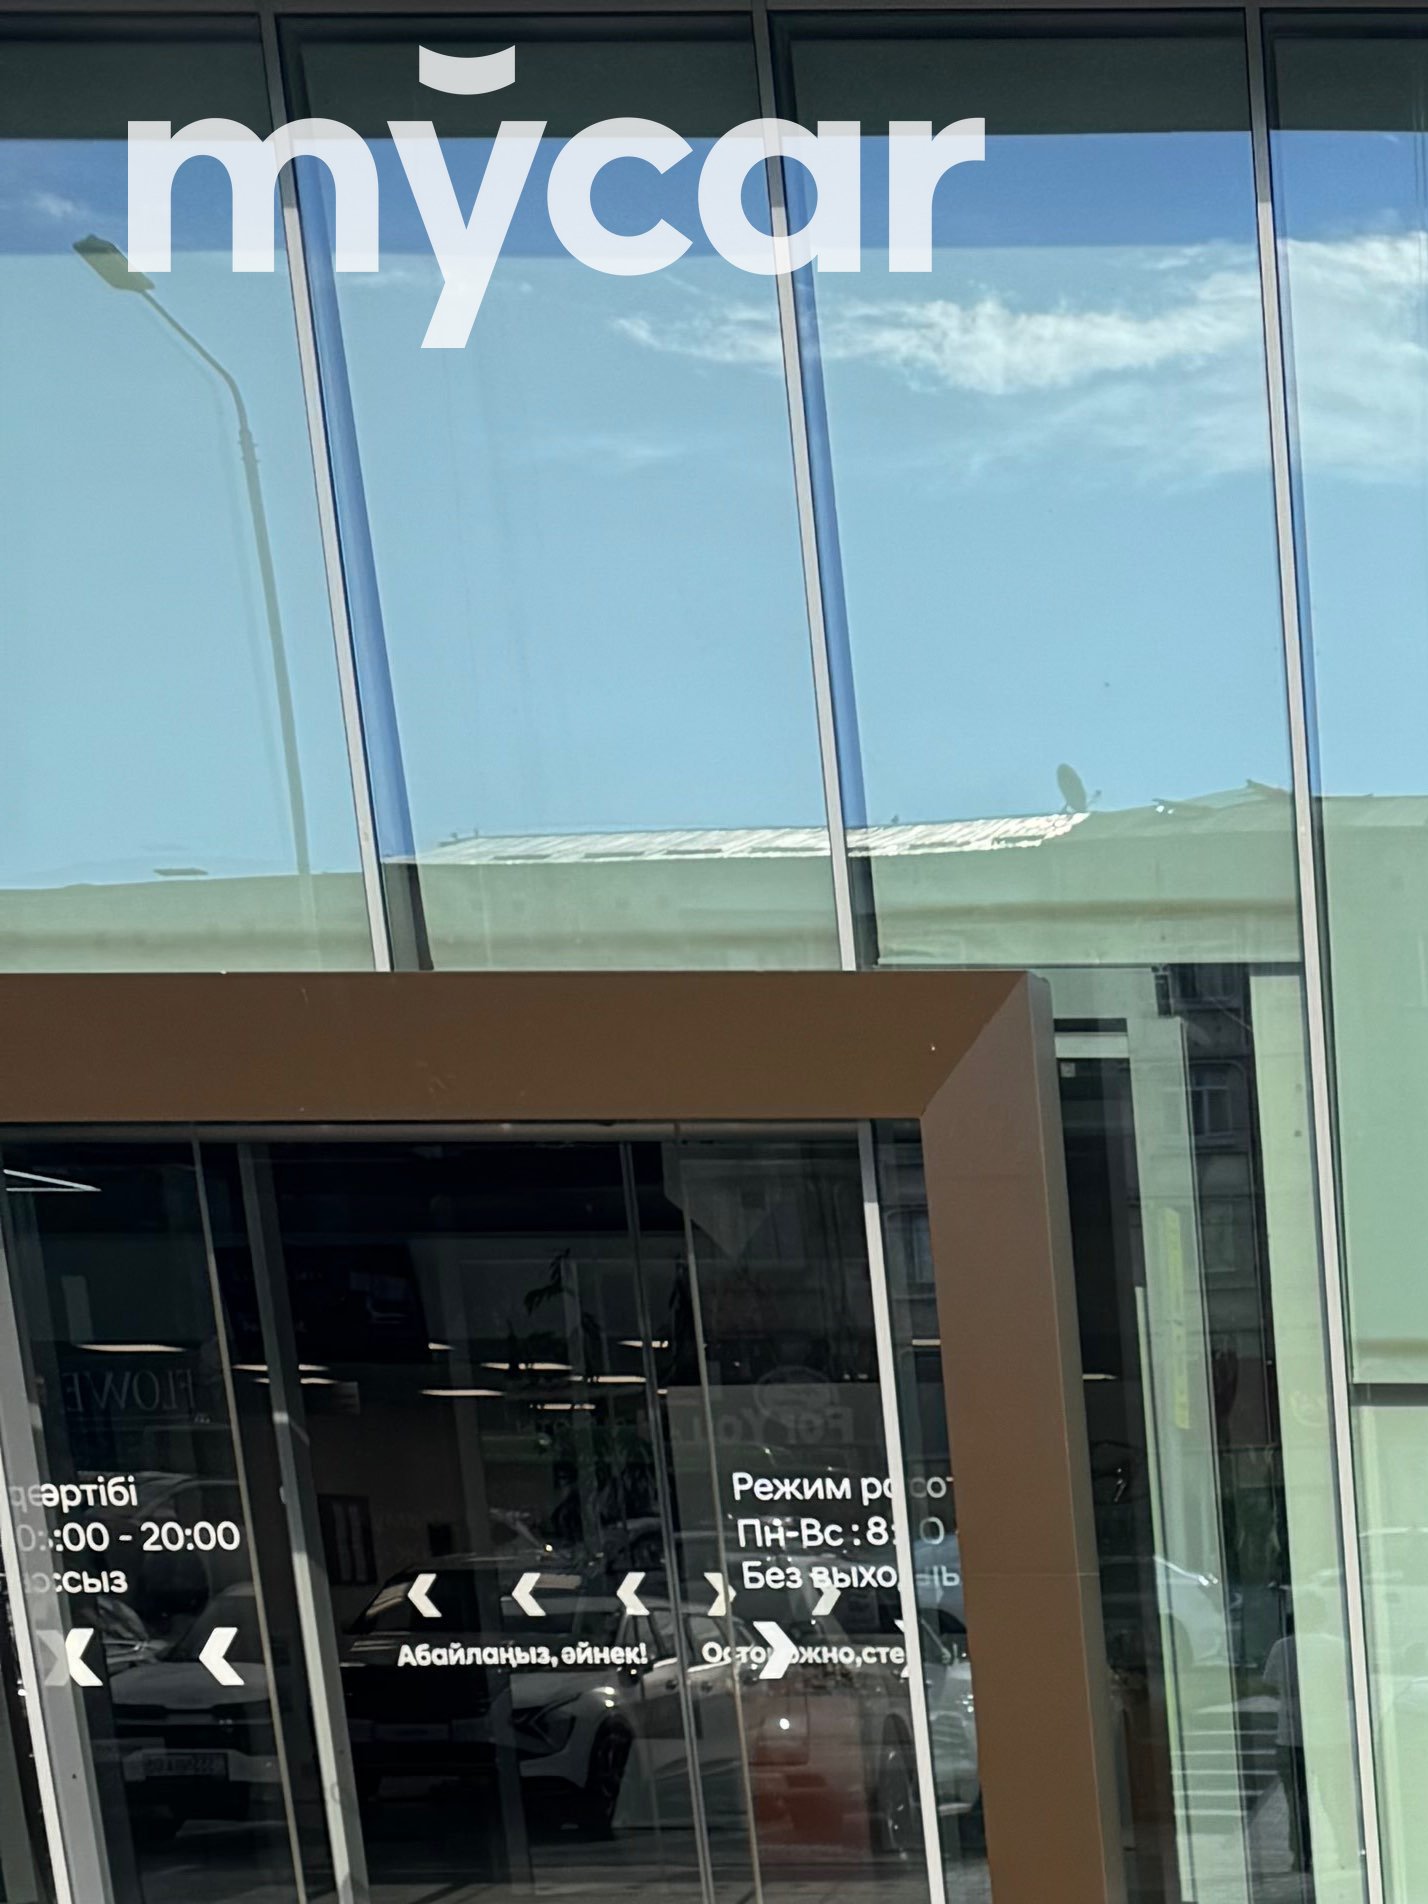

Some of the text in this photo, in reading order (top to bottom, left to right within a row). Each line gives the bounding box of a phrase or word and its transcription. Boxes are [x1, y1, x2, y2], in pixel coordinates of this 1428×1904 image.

[732, 1472, 852, 1501] Режим
[140, 1521, 241, 1551] 20:00
[742, 1561, 802, 1589] Без
